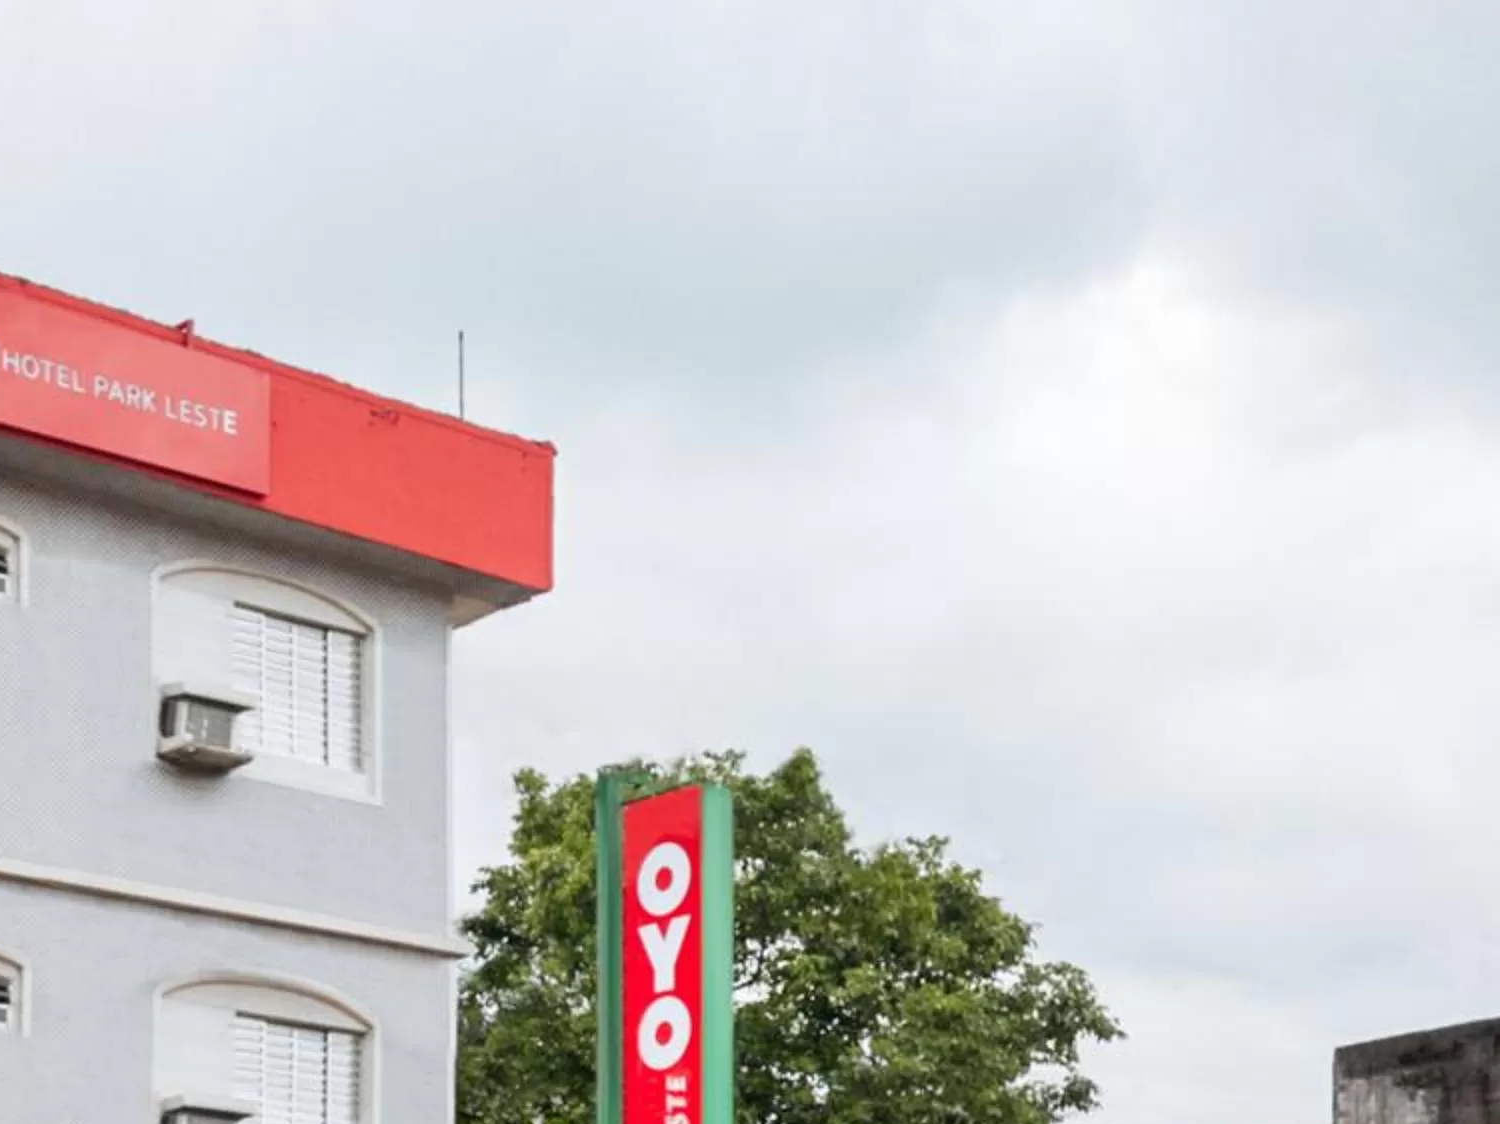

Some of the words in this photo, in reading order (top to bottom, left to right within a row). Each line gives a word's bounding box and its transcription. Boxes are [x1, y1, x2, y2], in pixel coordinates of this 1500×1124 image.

[2, 349, 86, 394] HOTEL
[93, 375, 157, 413] PARK
[164, 396, 238, 435] LESTE
[637, 842, 692, 1071] OYO
